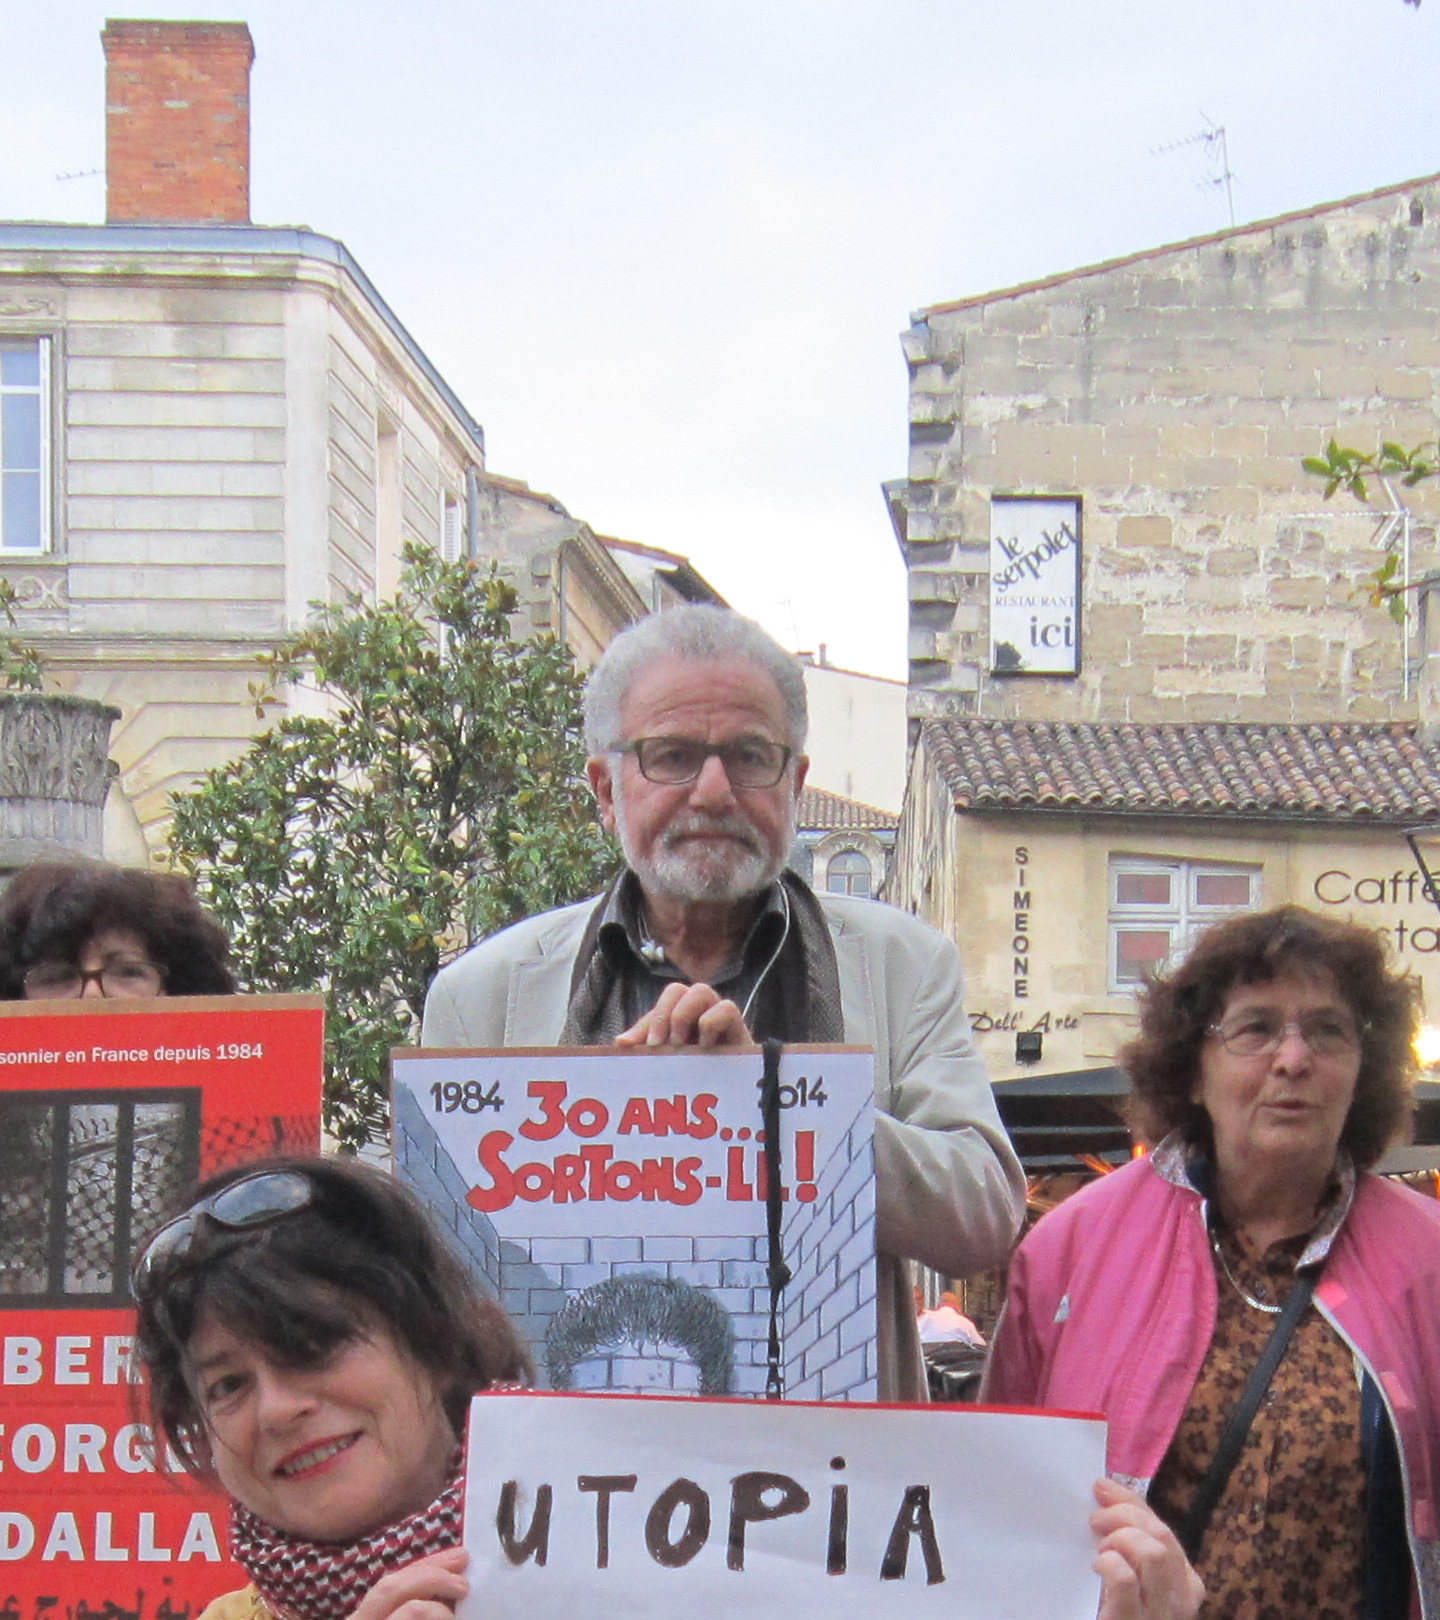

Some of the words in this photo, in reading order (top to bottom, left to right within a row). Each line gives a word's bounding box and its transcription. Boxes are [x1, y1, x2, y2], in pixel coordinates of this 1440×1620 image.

[992, 520, 1079, 593] serpolet
[995, 534, 1024, 561] le
[994, 595, 1076, 608] RESTAURANT
[1030, 615, 1076, 648] ici
[1013, 846, 1031, 999] SIMEONE
[968, 1010, 1023, 1032] Dell'
[1032, 1012, 1079, 1034] Arte
[65, 1050, 87, 1064] en
[91, 1046, 150, 1063] France
[153, 1045, 211, 1065] depuis
[215, 1043, 264, 1060] 1984
[429, 1079, 505, 1114] 1984
[517, 1079, 610, 1142] 30
